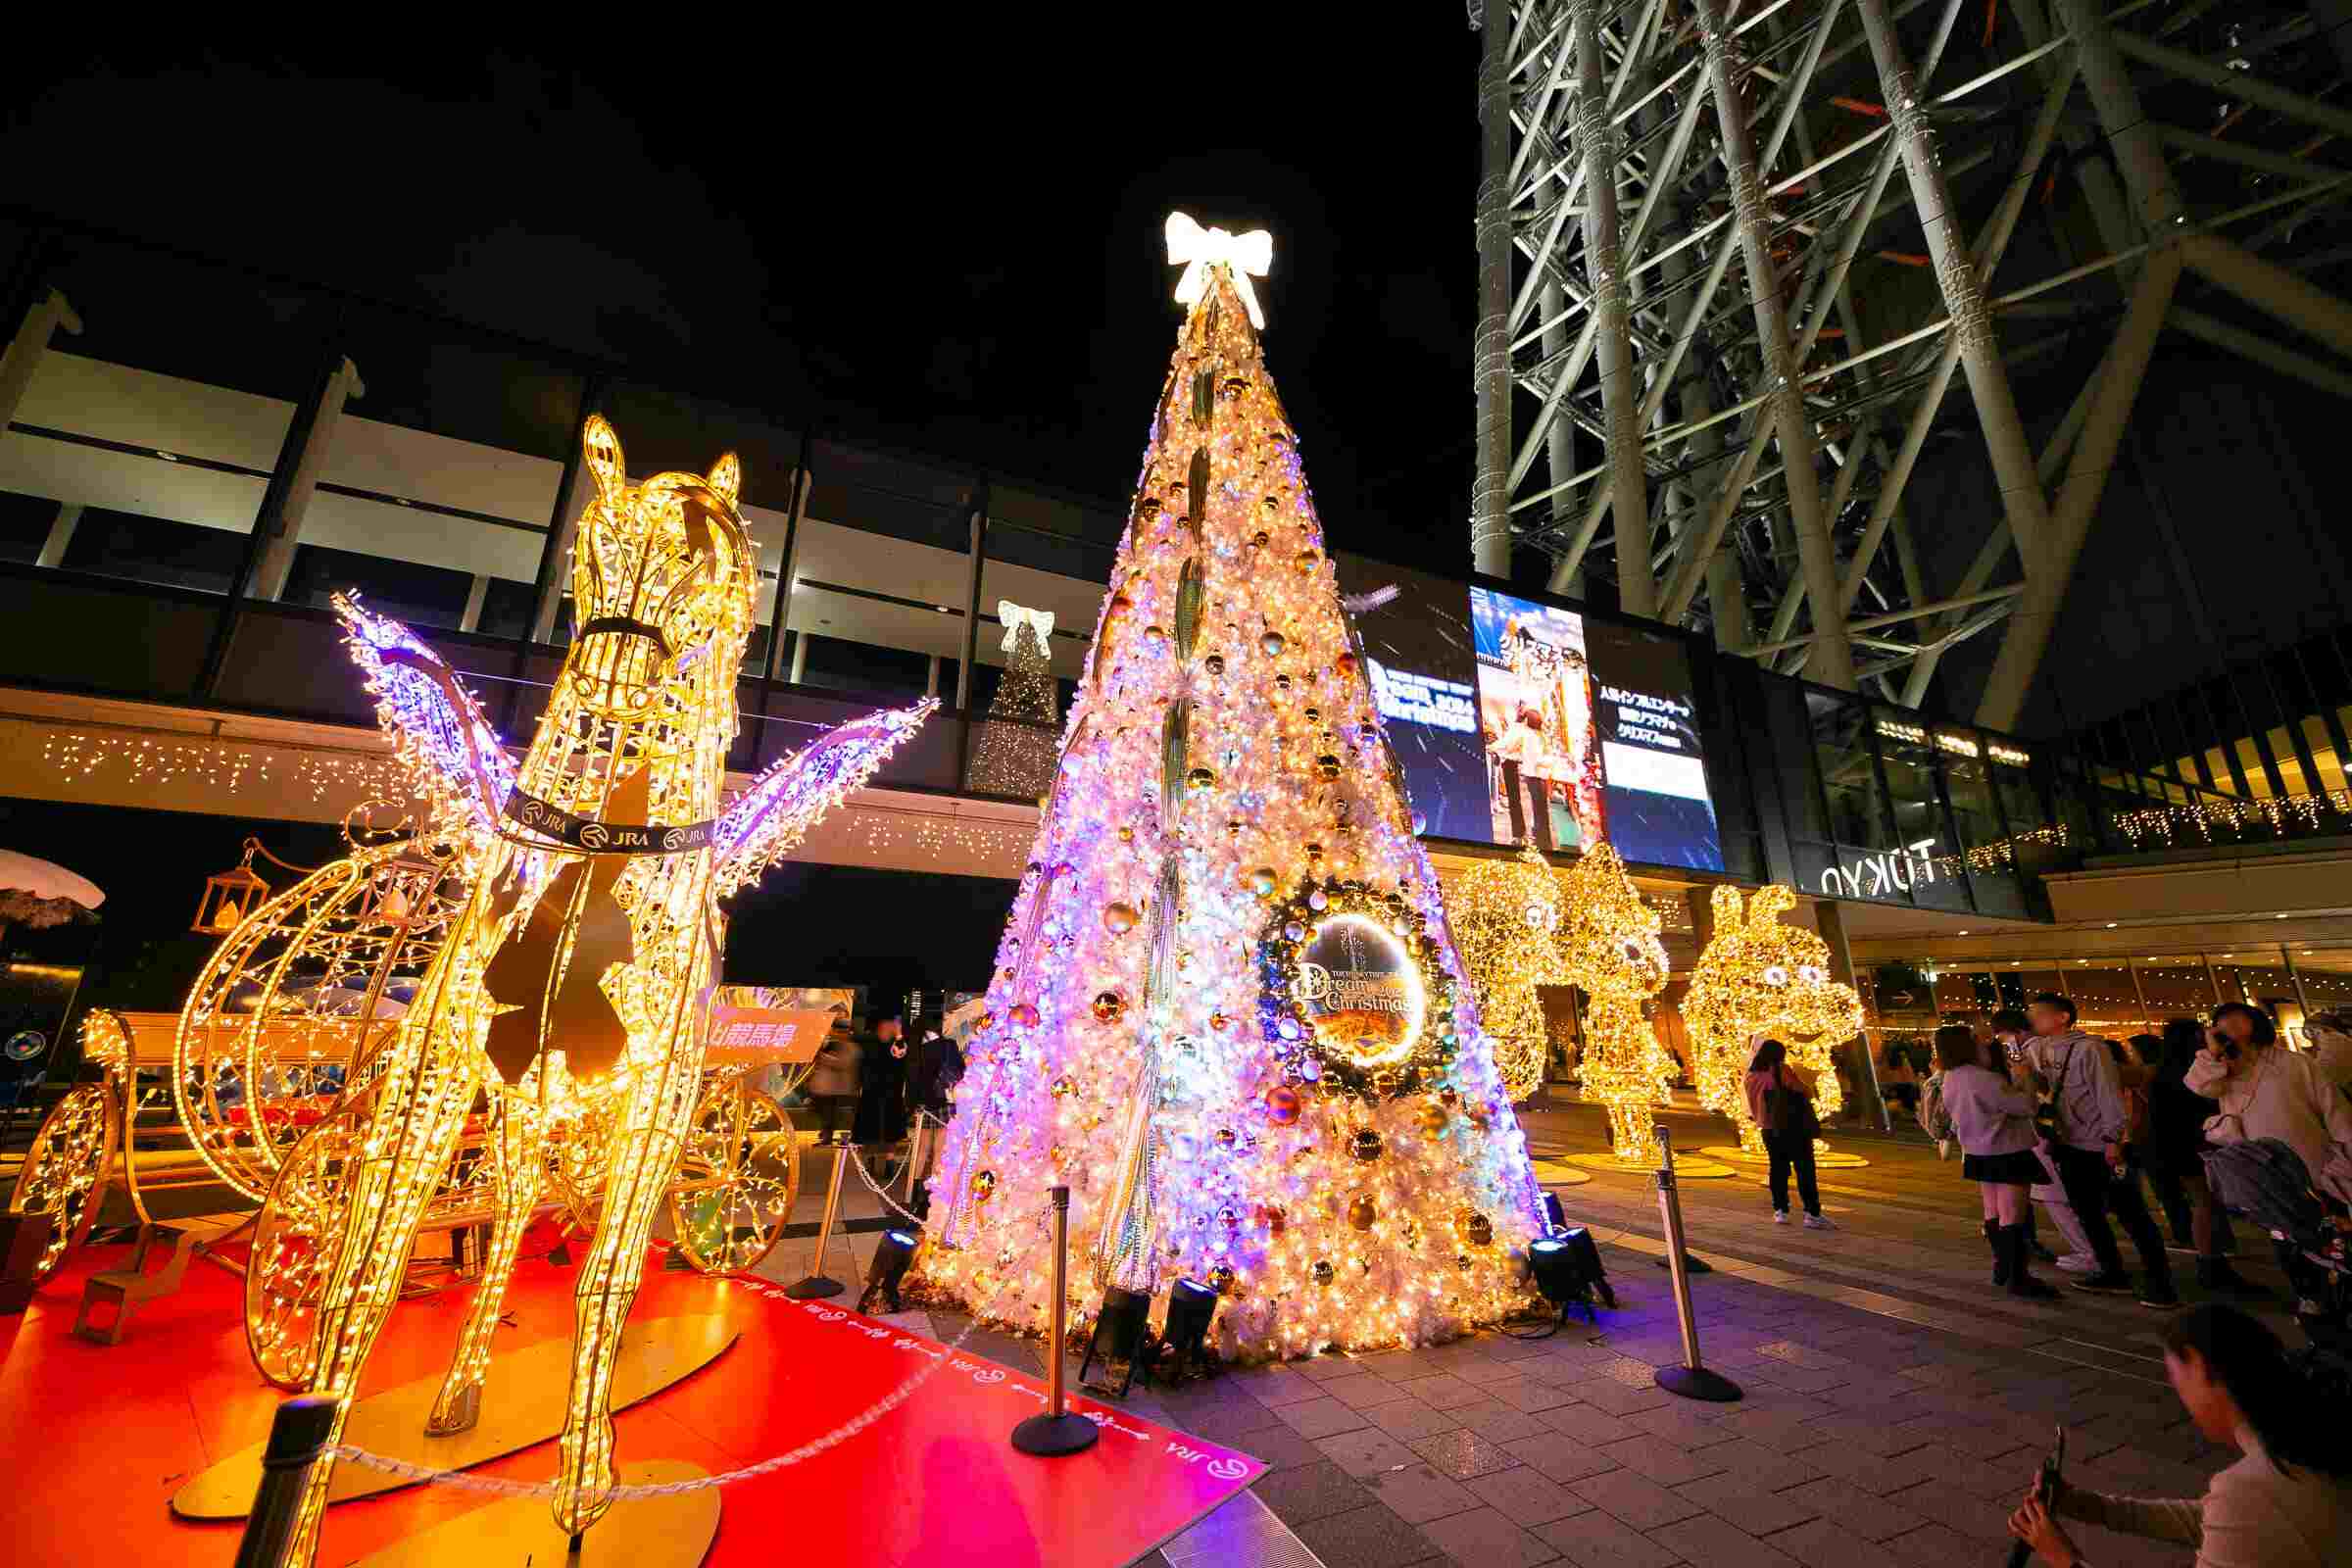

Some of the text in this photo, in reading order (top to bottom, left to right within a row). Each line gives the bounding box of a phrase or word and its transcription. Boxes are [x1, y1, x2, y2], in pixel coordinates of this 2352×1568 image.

[541, 813, 565, 832] JRA
[612, 831, 649, 847] JRA
[1295, 961, 1368, 1002] Dream
[1325, 992, 1412, 1012] Christmas
[1165, 1443, 1210, 1463] JRA
